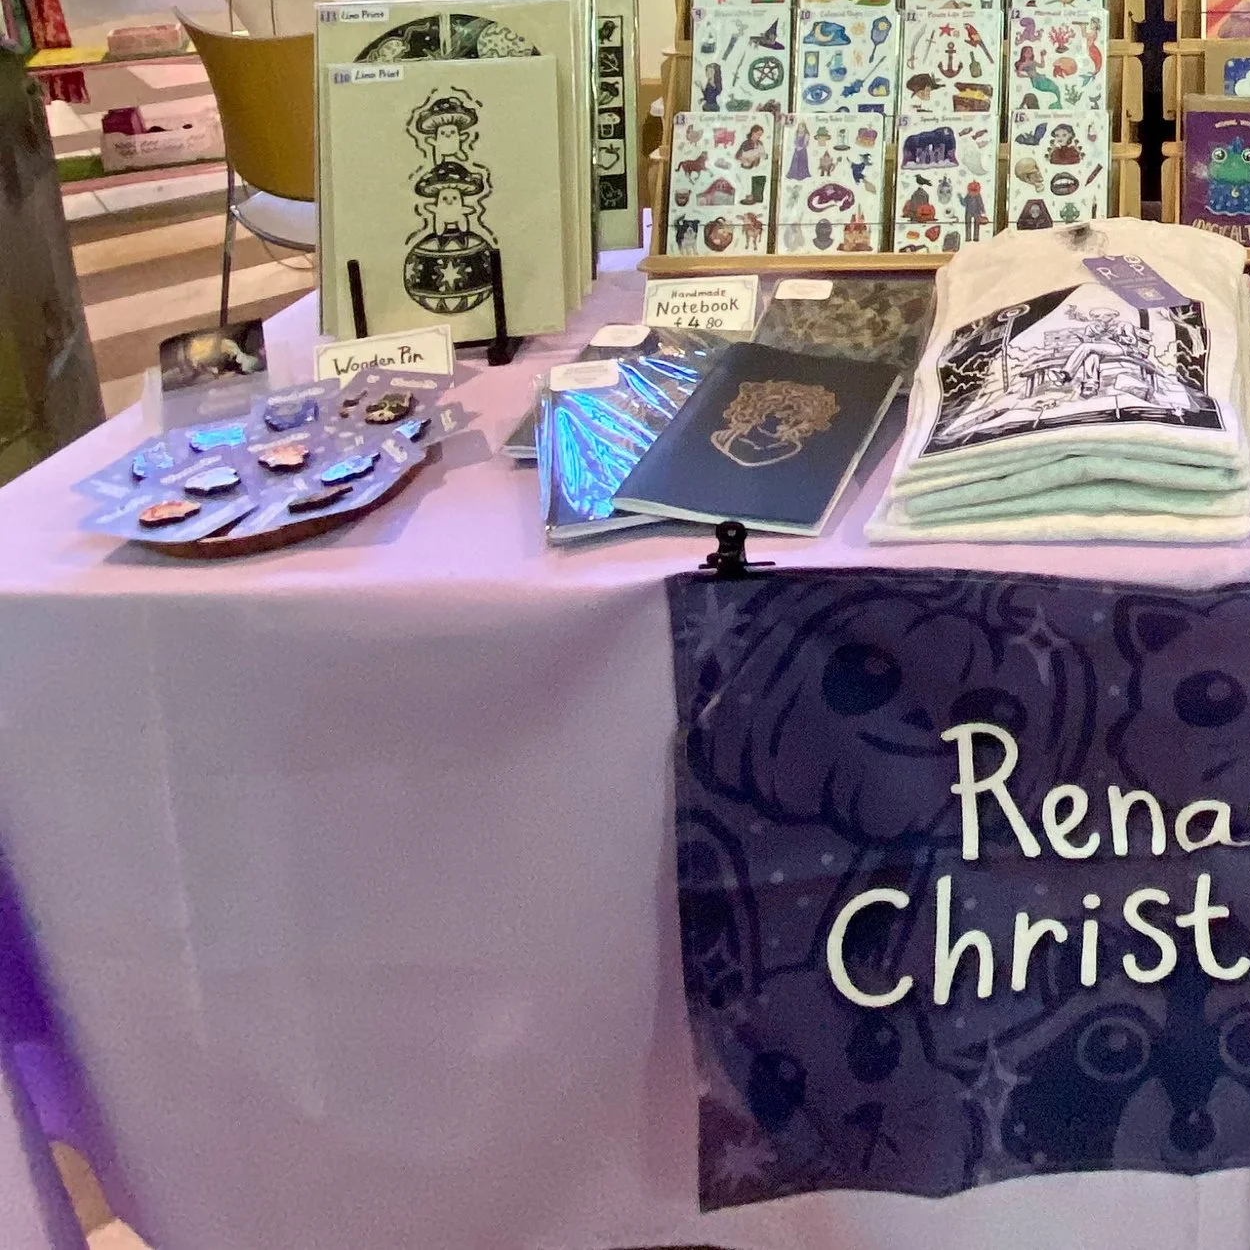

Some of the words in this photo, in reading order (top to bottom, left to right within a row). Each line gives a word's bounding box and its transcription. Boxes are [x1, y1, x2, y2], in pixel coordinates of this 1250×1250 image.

[800, 10, 811, 20] 10
[1010, 10, 1020, 19] 12
[898, 116, 908, 126] 15
[1014, 112, 1025, 123] 16
[671, 288, 727, 300] Handmade
[656, 298, 740, 317] Notebook
[398, 345, 424, 364] Pin
